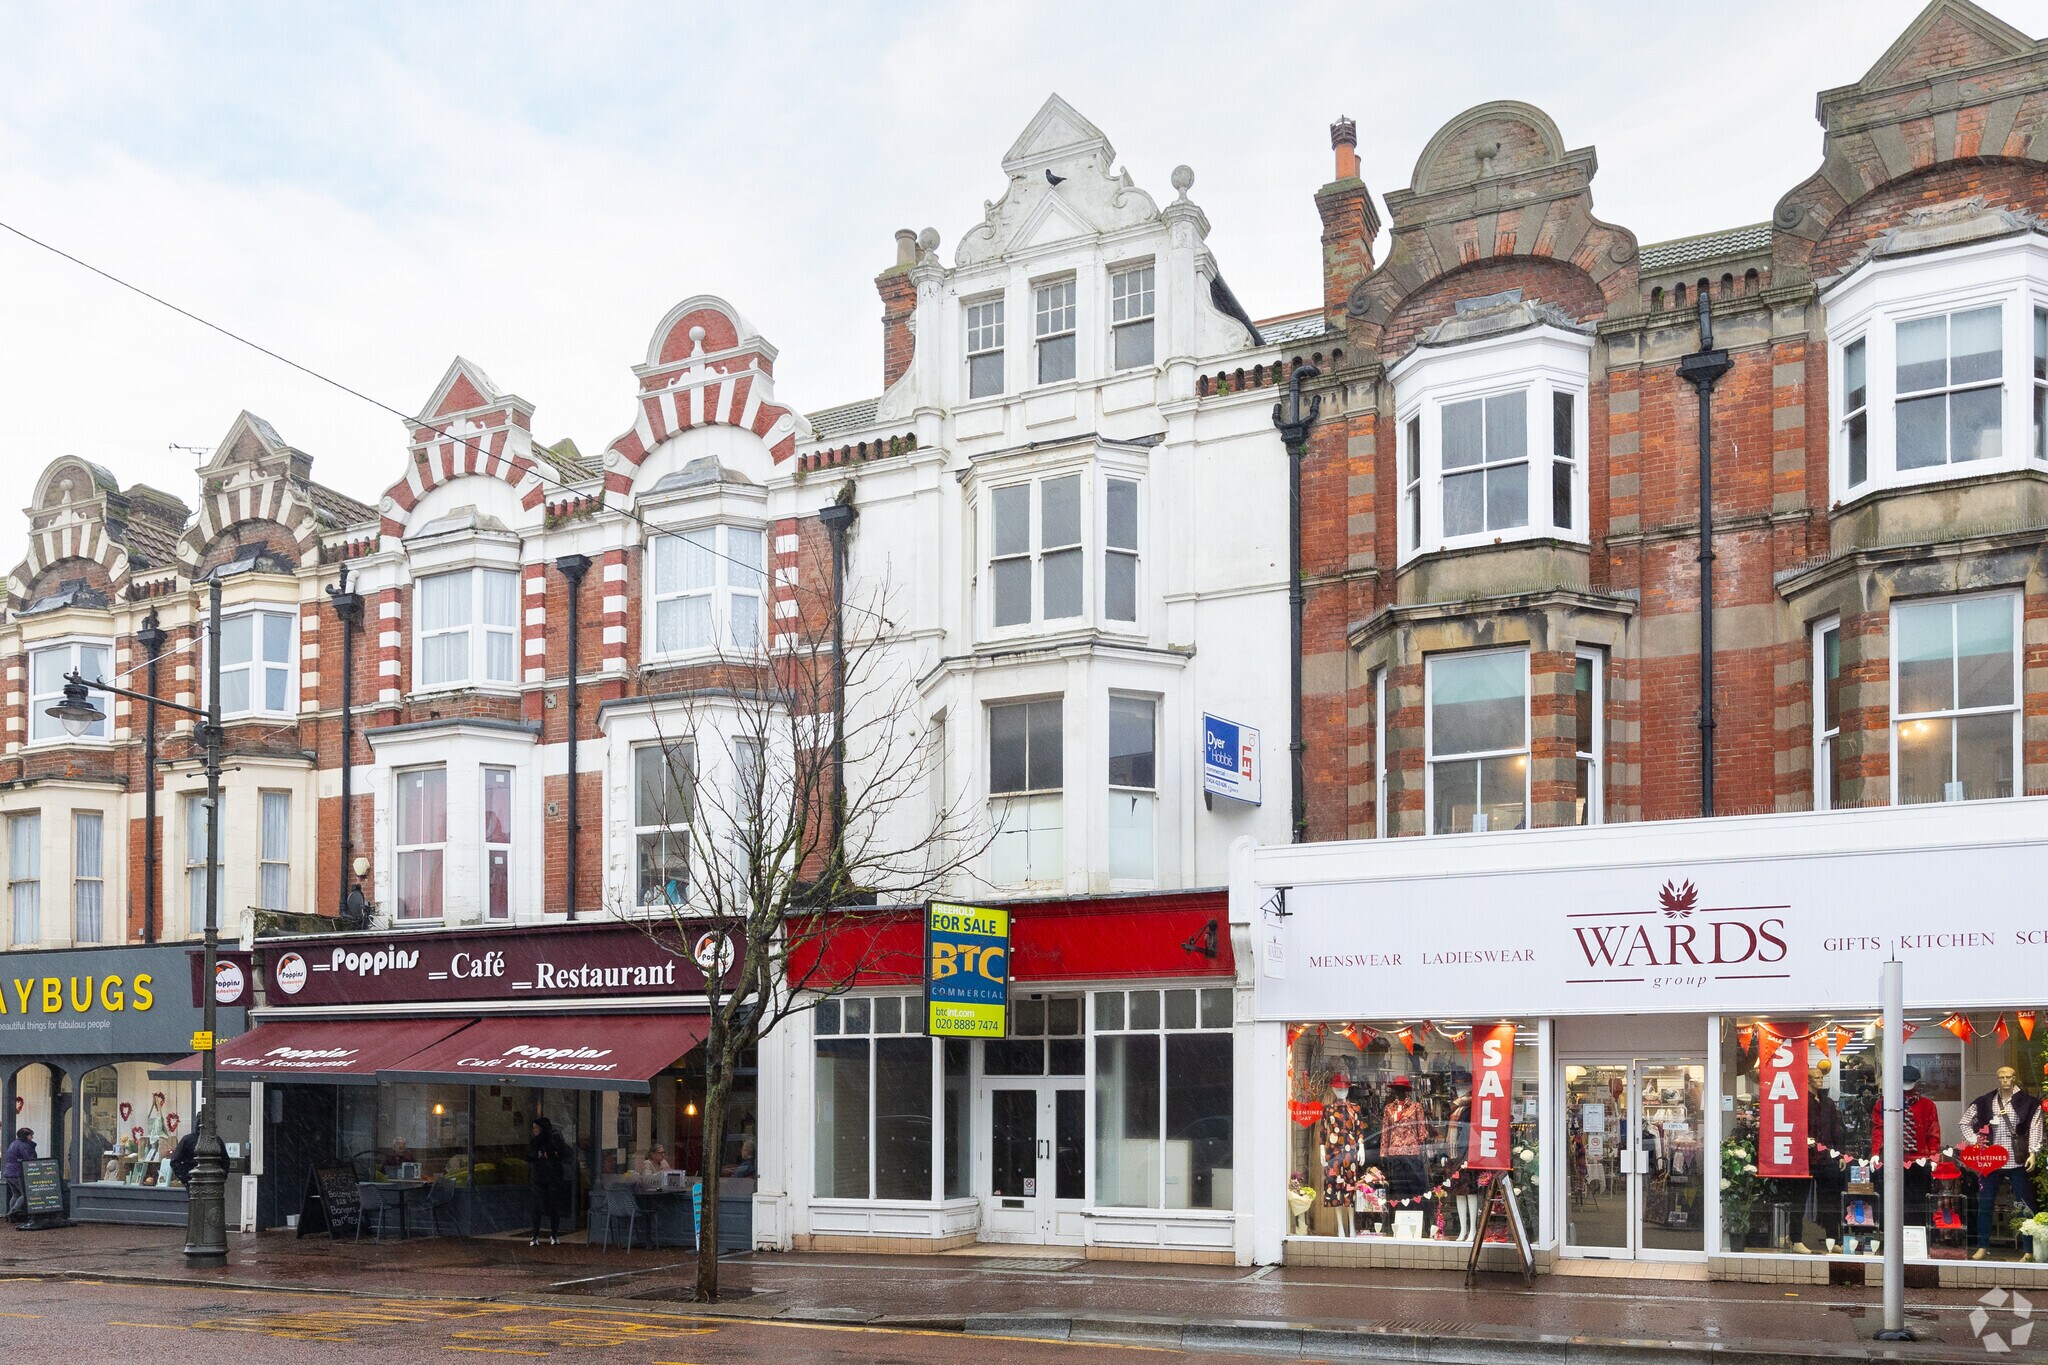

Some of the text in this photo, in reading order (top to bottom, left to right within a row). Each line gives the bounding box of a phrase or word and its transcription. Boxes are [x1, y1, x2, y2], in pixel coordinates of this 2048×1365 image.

[1207, 730, 1226, 750] Dyer
[1242, 745, 1252, 781] LET
[933, 903, 976, 917] FREEHOLD
[932, 914, 997, 934] FOR SALE
[1572, 918, 1788, 967] WARDS
[1823, 936, 1881, 952] GIFTS
[1900, 931, 1996, 949] KITCHEN
[932, 942, 1005, 985] BTC
[1309, 948, 1536, 968] MENSWEAR LADIESWEAR
[332, 943, 676, 989] Poppins Café Restaurant
[1653, 975, 1708, 988] group
[931, 987, 1004, 999] COMMERCIAL
[935, 1006, 975, 1018] btcint.com
[2017, 1010, 2036, 1018] SALE
[27, 1021, 47, 1032] things
[48, 1020, 58, 1029] for
[58, 1020, 87, 1029] fabulous
[87, 1019, 111, 1030] people
[935, 1018, 999, 1031] 020 8889 7474
[1903, 1023, 1917, 1033] ALE
[1767, 1034, 1783, 1044] SALE
[1837, 1028, 1854, 1037] SALE
[264, 1047, 360, 1060] Poppins
[502, 1044, 613, 1060] Poppins
[456, 1057, 618, 1071] Café Restaurant
[1478, 1039, 1505, 1158] SALE
[1768, 1038, 1799, 1165] SALE
